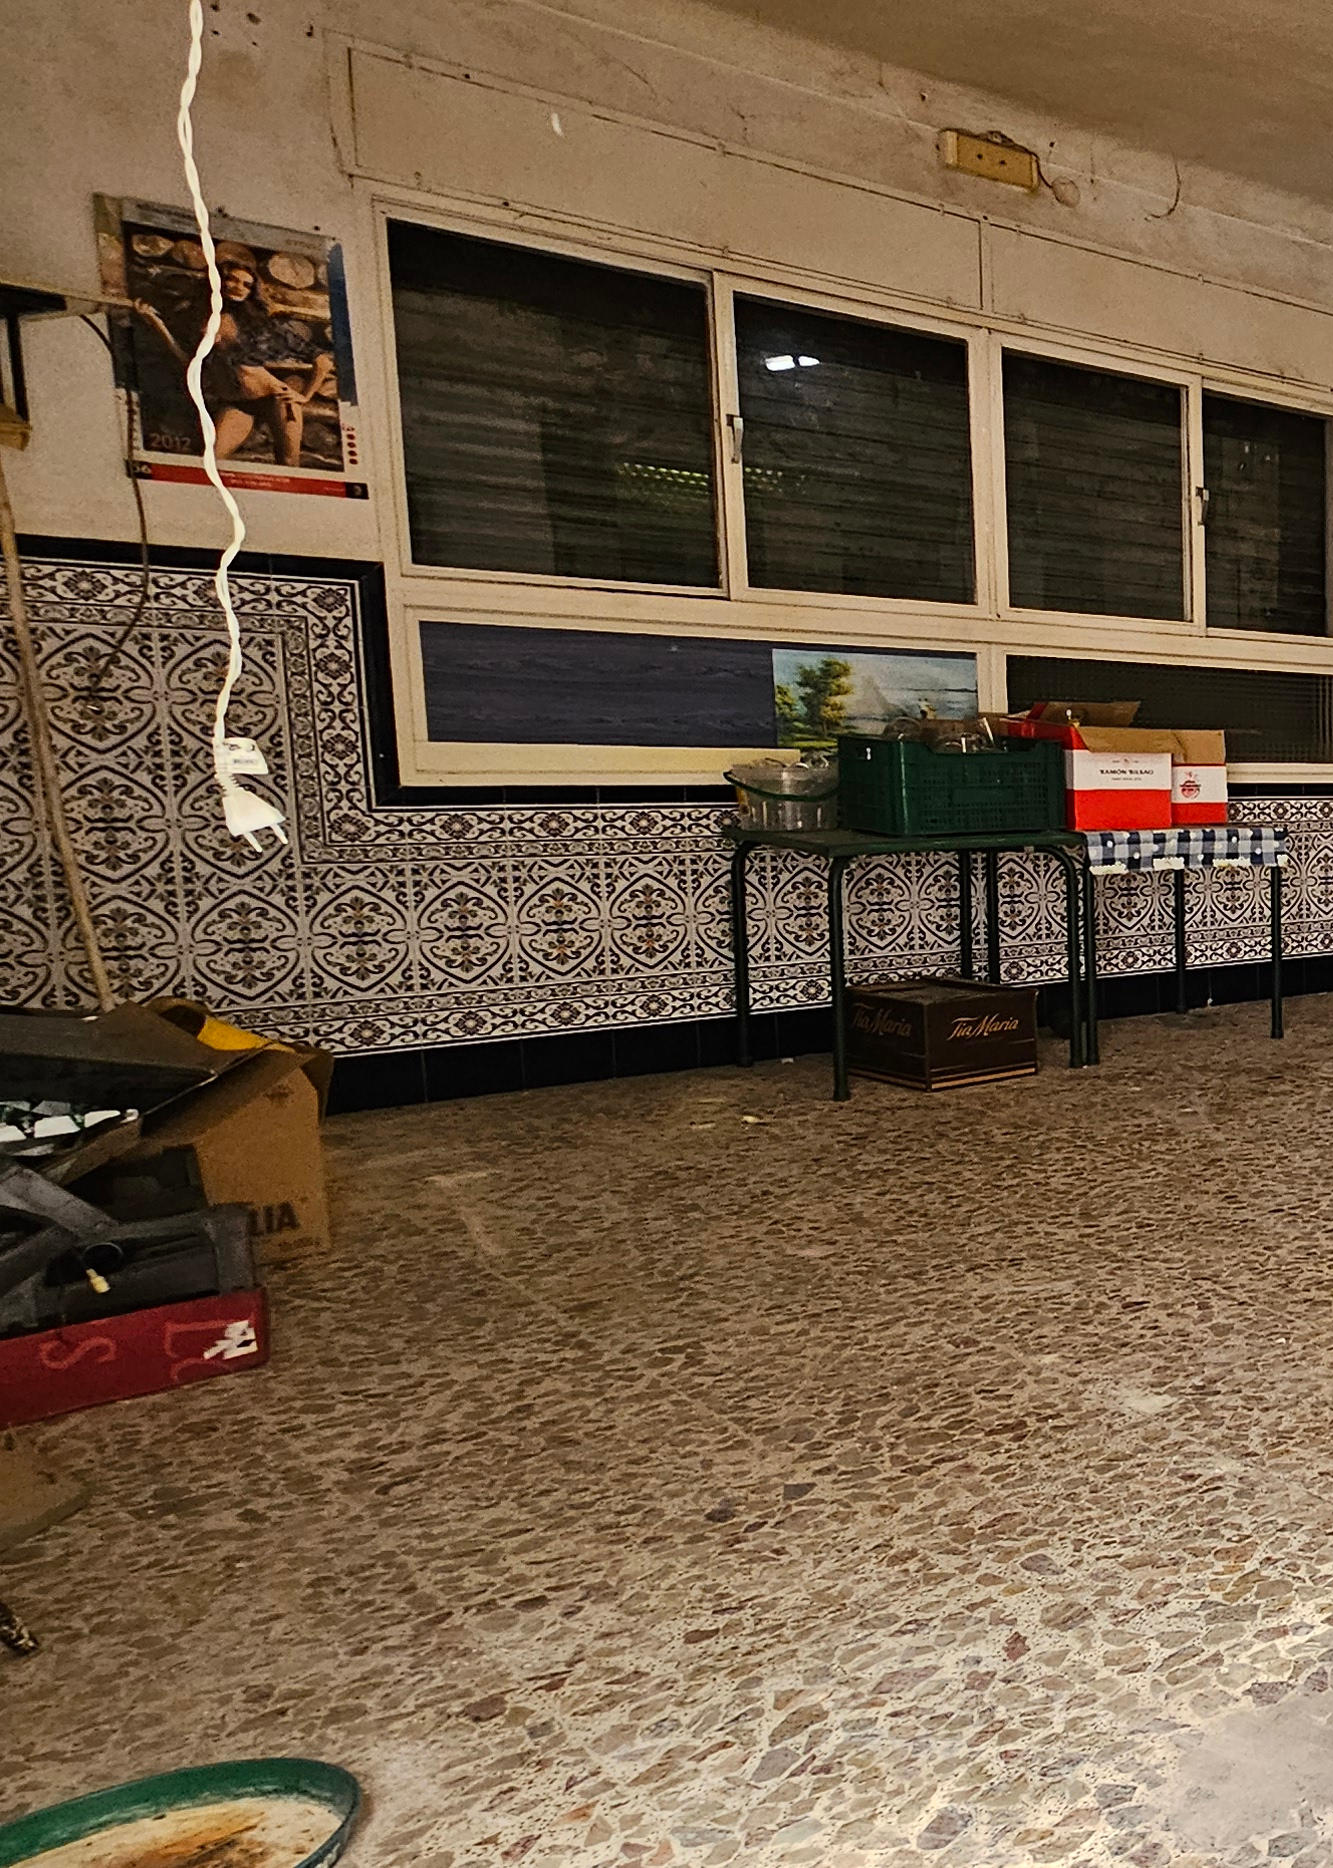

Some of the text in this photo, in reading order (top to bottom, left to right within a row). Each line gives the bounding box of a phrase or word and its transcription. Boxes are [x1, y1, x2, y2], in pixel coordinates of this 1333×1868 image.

[151, 432, 192, 451] 2012
[971, 1011, 1020, 1037] Maria
[249, 1202, 298, 1237] LIA
